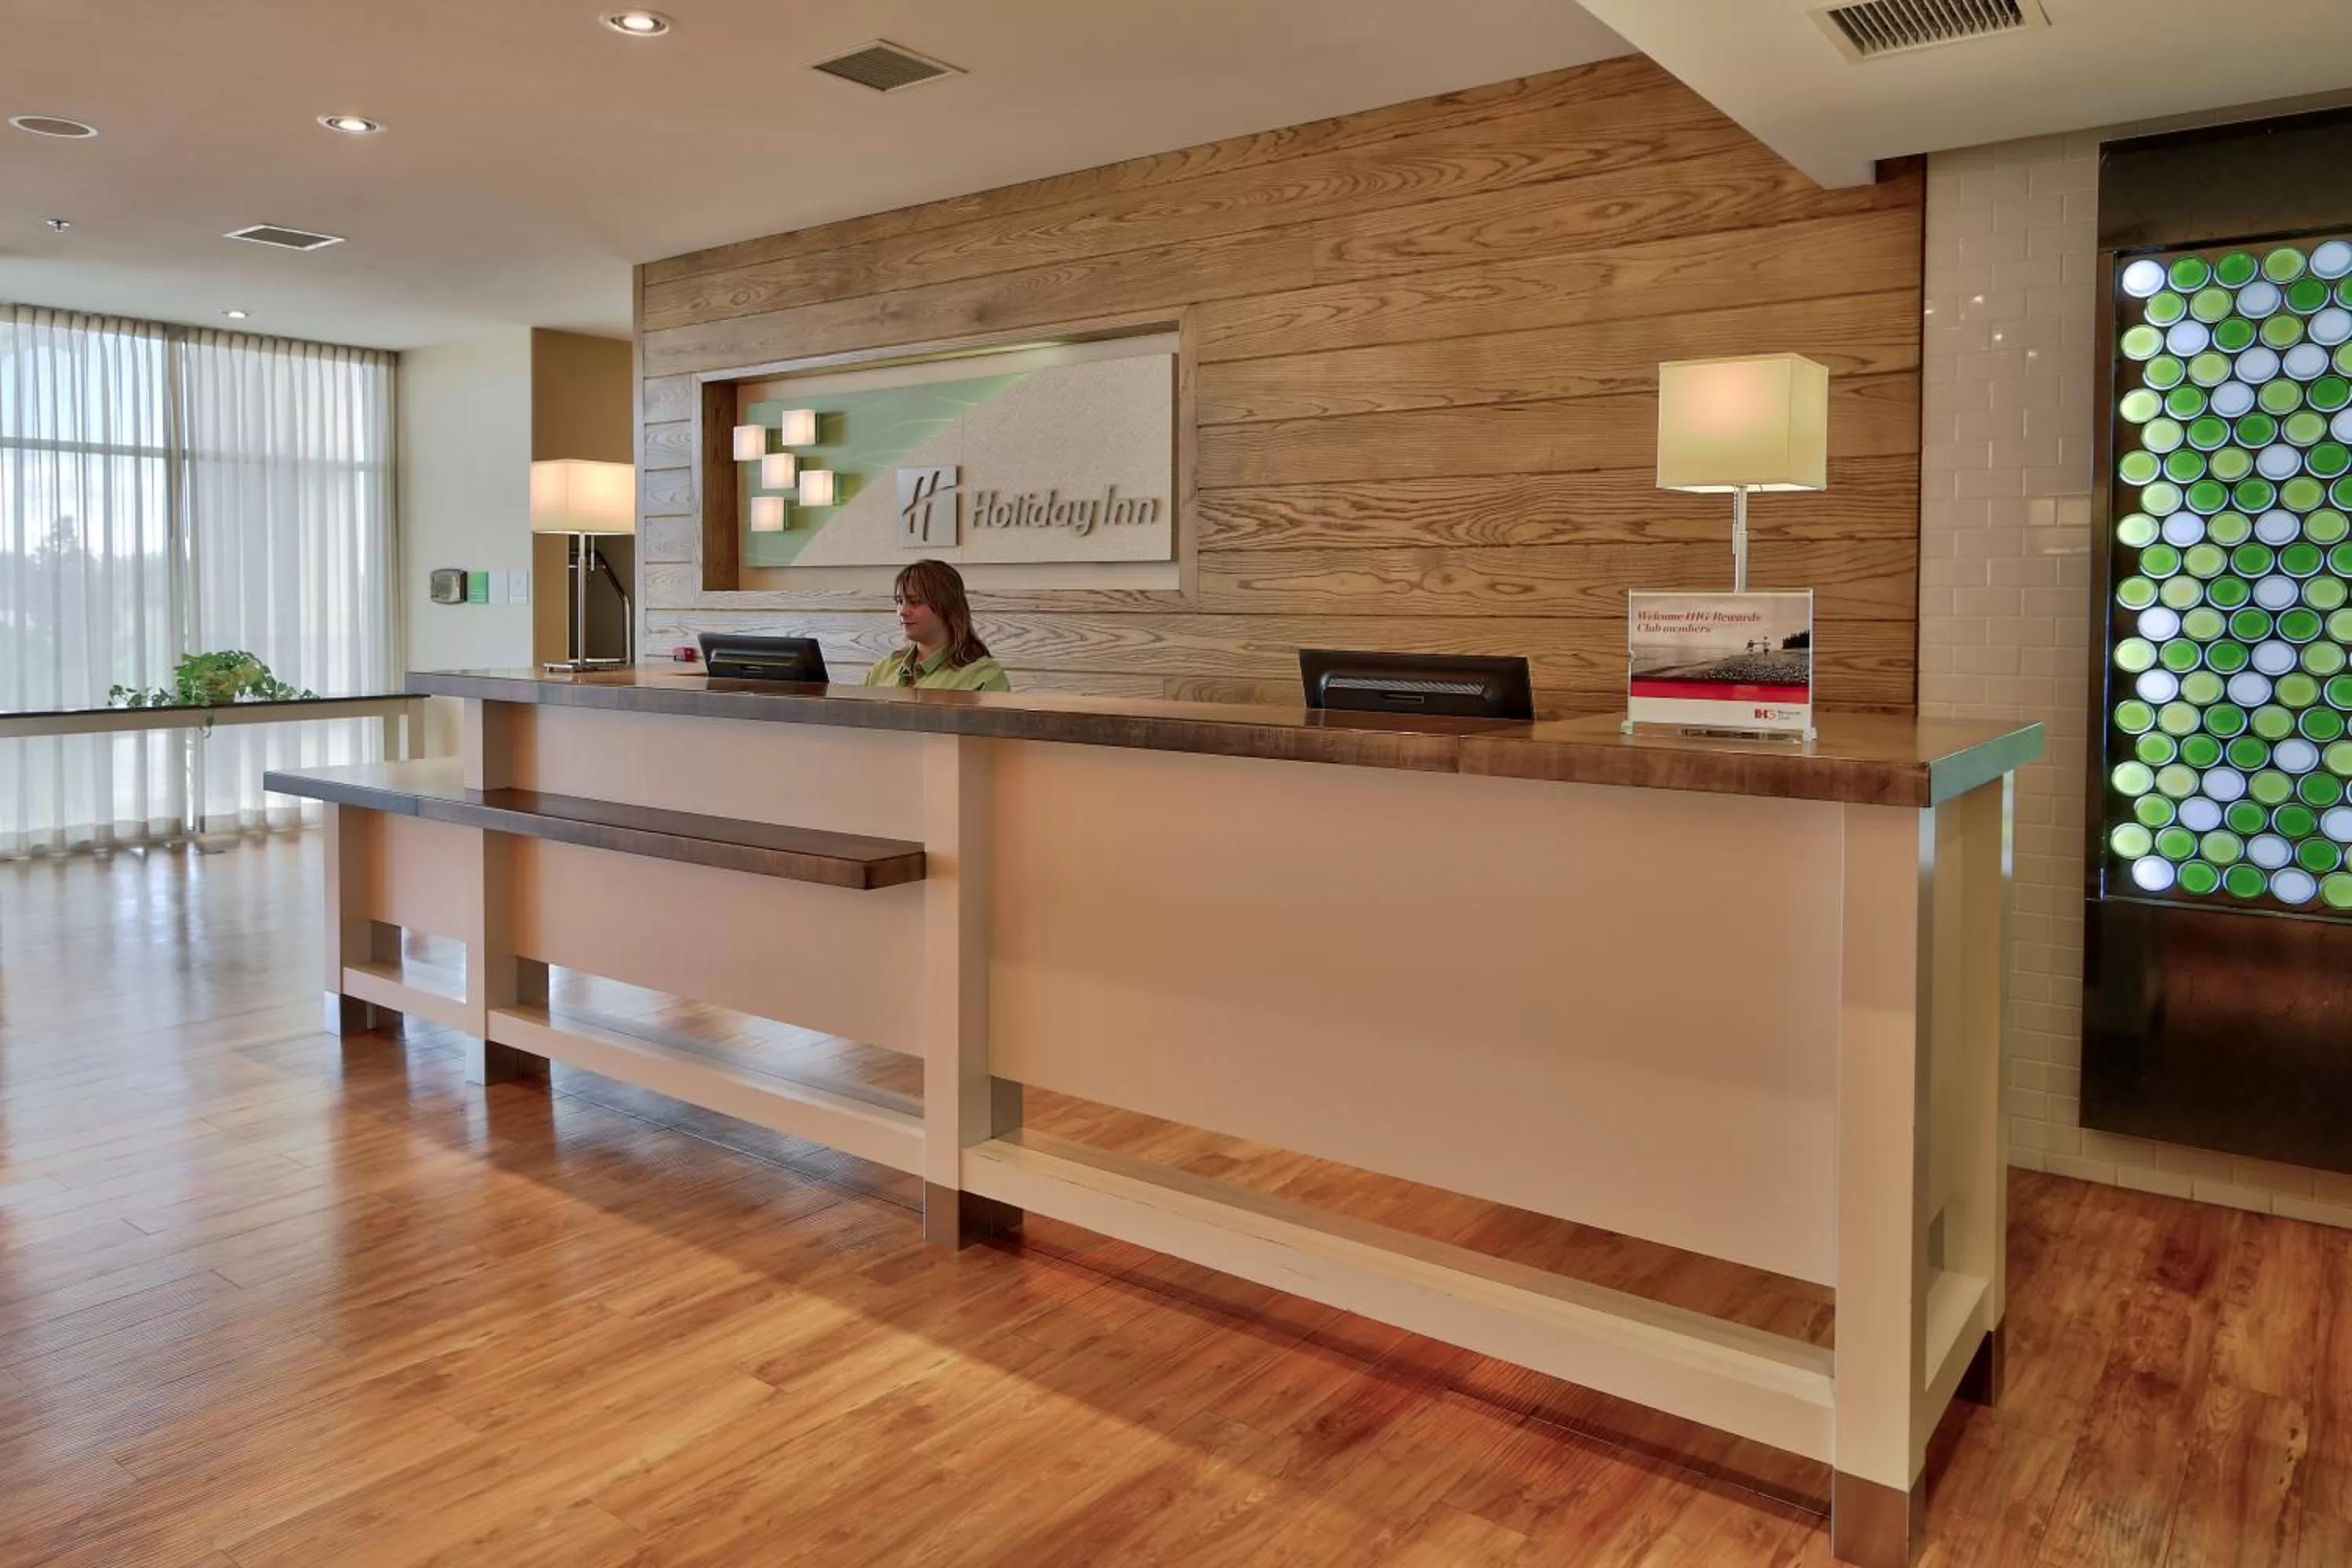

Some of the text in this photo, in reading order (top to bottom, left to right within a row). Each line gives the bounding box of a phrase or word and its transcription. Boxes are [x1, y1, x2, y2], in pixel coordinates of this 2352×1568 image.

[971, 484, 1160, 538] Holiday Inn
[1637, 611, 1762, 622] Welcome IHG Rewards
[1636, 623, 1711, 633] Club members
[1755, 708, 1777, 720] IHG
